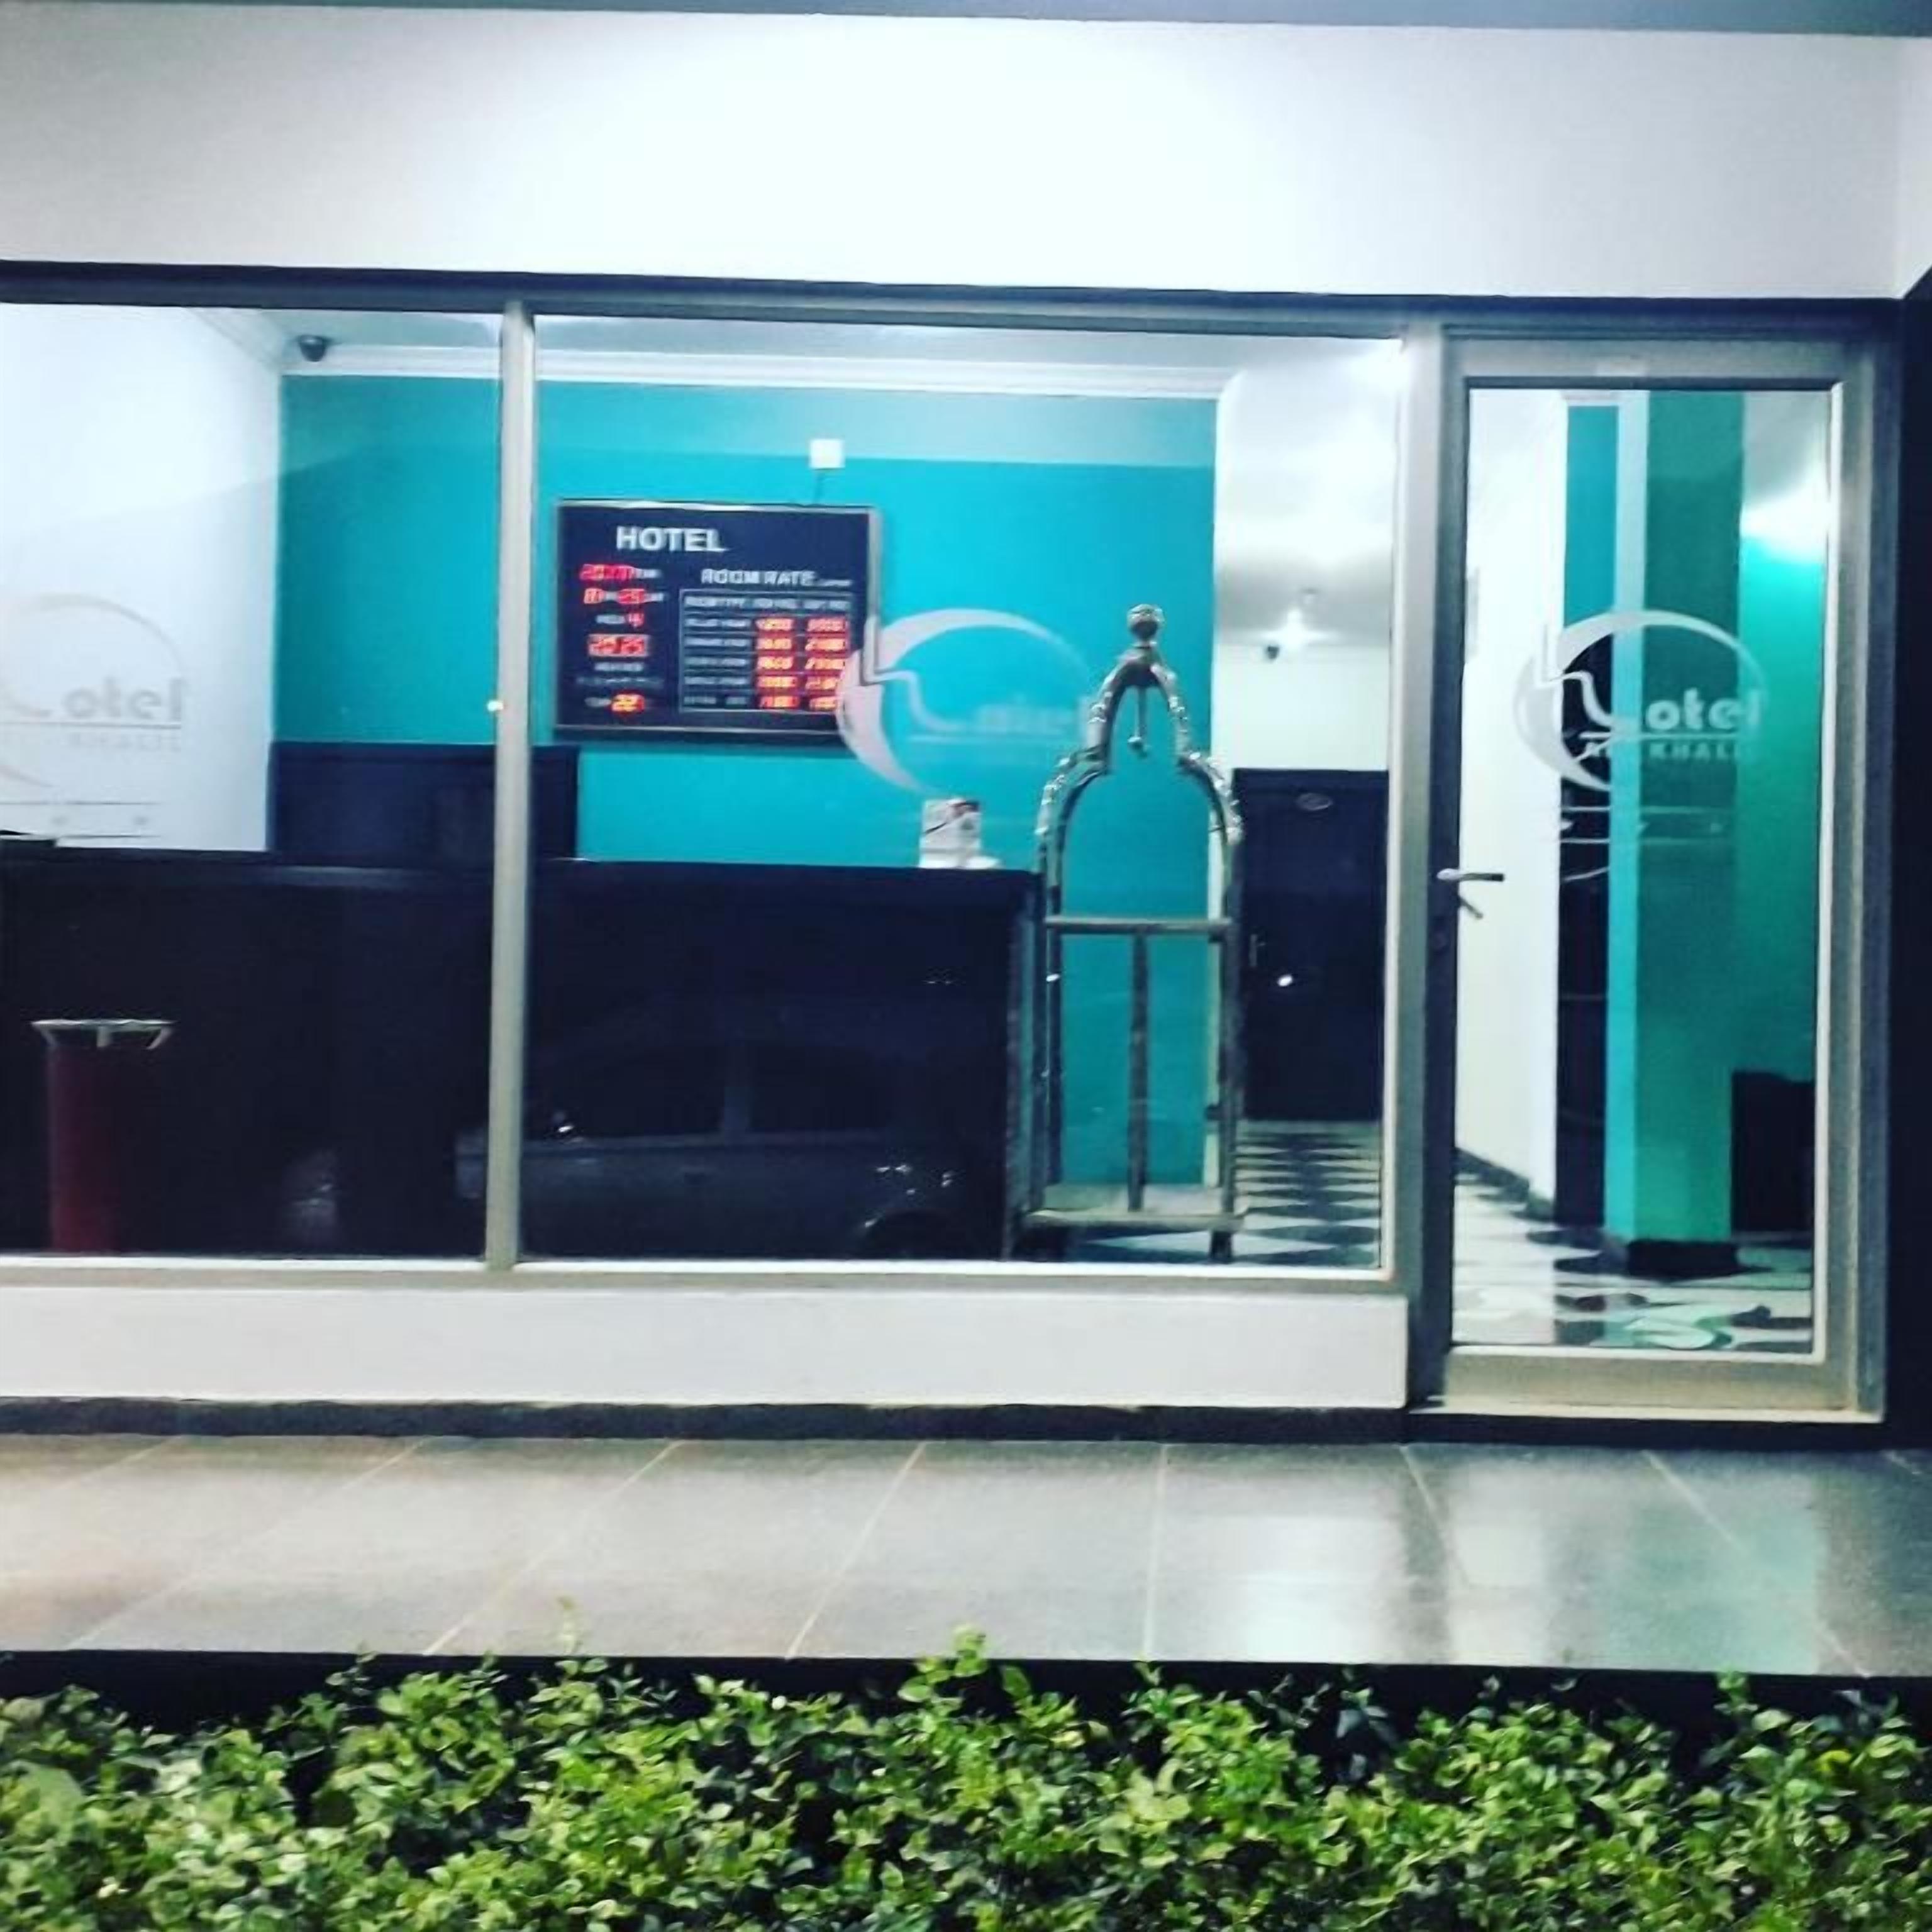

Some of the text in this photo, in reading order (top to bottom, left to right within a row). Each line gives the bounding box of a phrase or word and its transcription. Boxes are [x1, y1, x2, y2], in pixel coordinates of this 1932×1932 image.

[616, 525, 727, 552] HOTEL
[701, 569, 759, 584] ROOM
[764, 570, 816, 586] RATE
